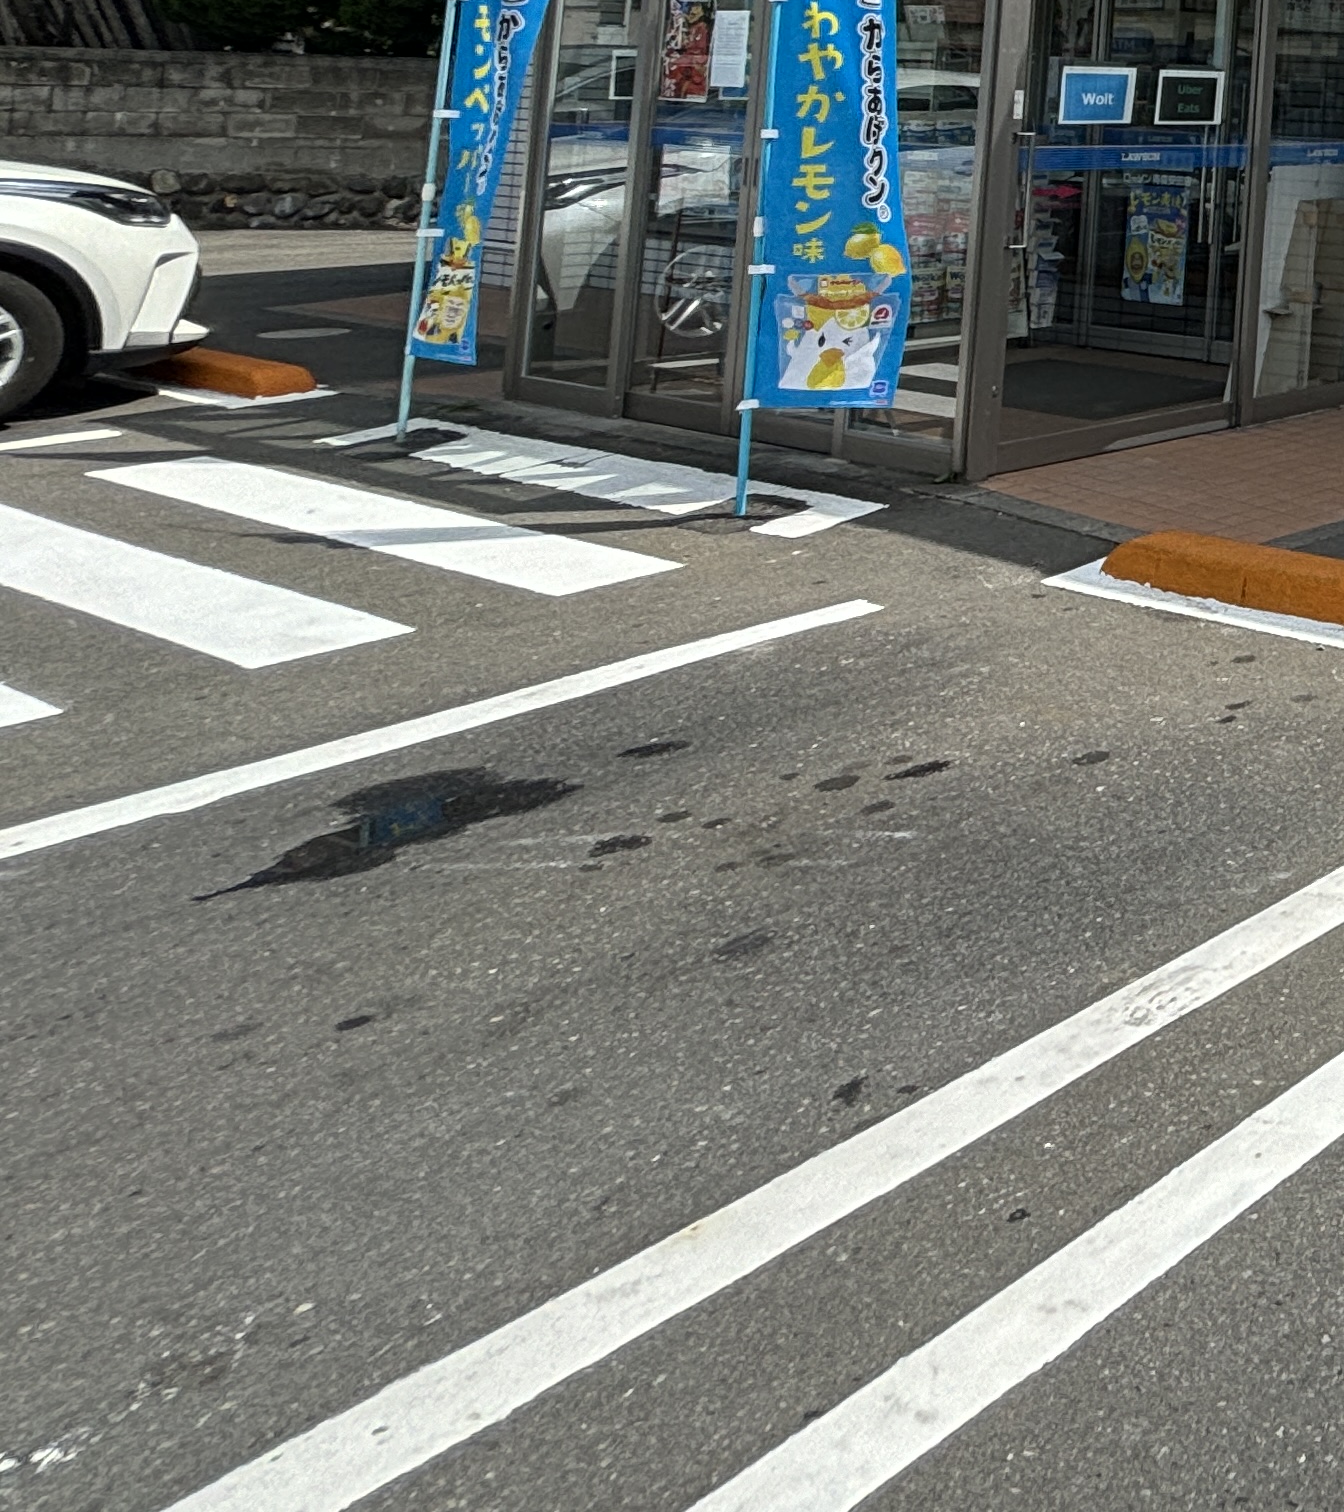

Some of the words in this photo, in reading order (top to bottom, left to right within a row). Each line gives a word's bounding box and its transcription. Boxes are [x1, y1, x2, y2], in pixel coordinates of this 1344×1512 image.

[1177, 85, 1203, 96] Uber
[1081, 92, 1115, 106] Wolt
[1177, 103, 1200, 114] Eats
